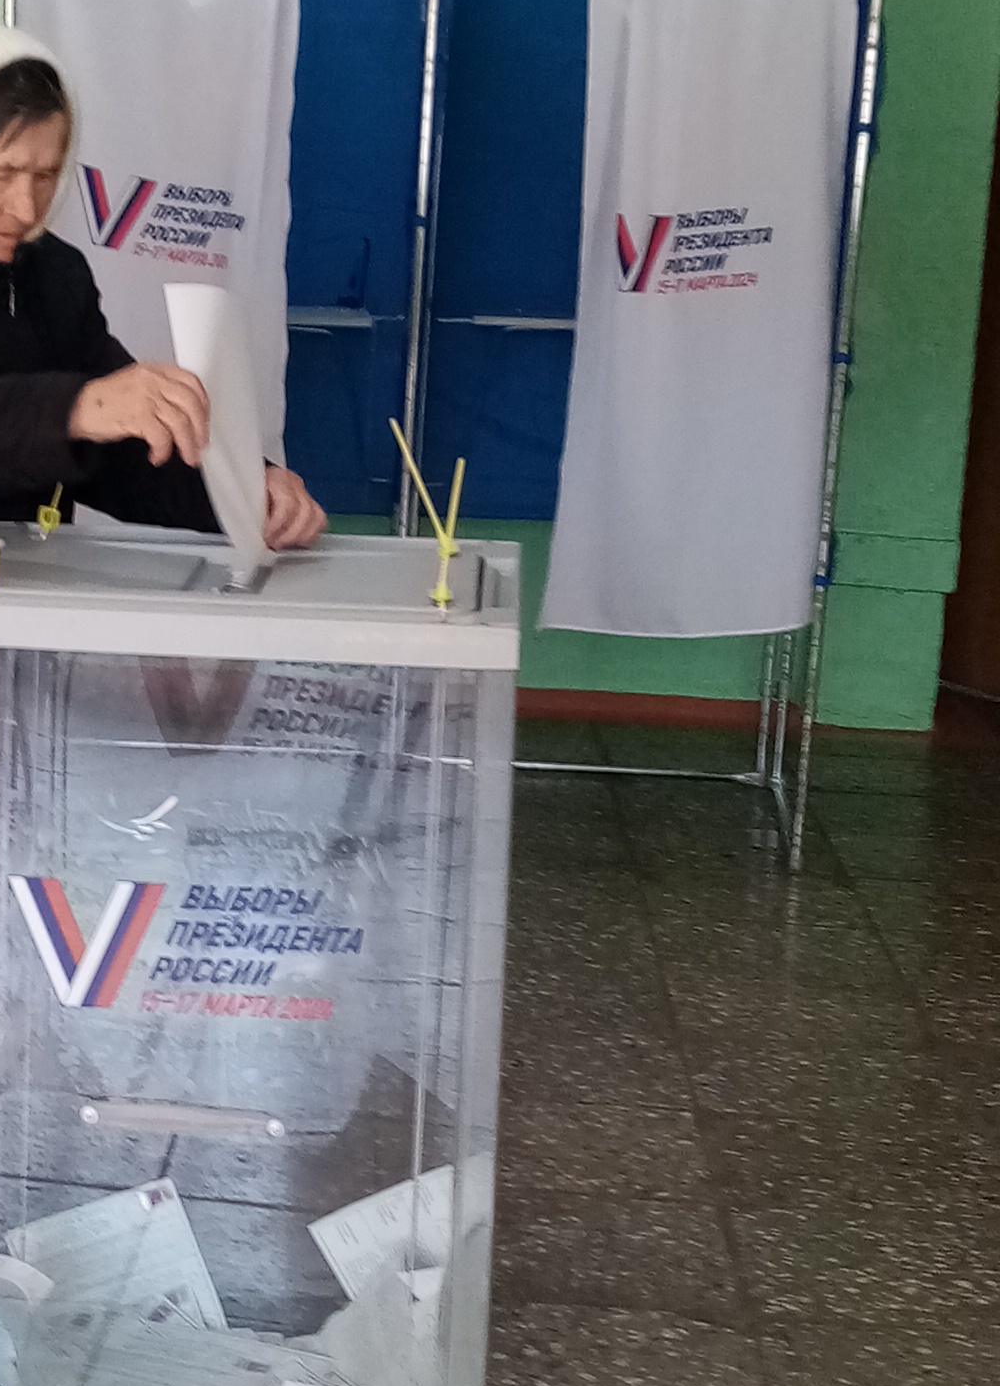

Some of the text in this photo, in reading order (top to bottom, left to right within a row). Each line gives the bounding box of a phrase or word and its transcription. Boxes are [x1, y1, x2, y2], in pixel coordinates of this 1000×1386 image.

[179, 883, 324, 916] ВЫБОРЫ
[164, 919, 365, 955] ПРЕЗИДЕНТА
[148, 955, 278, 987] РОССИИ
